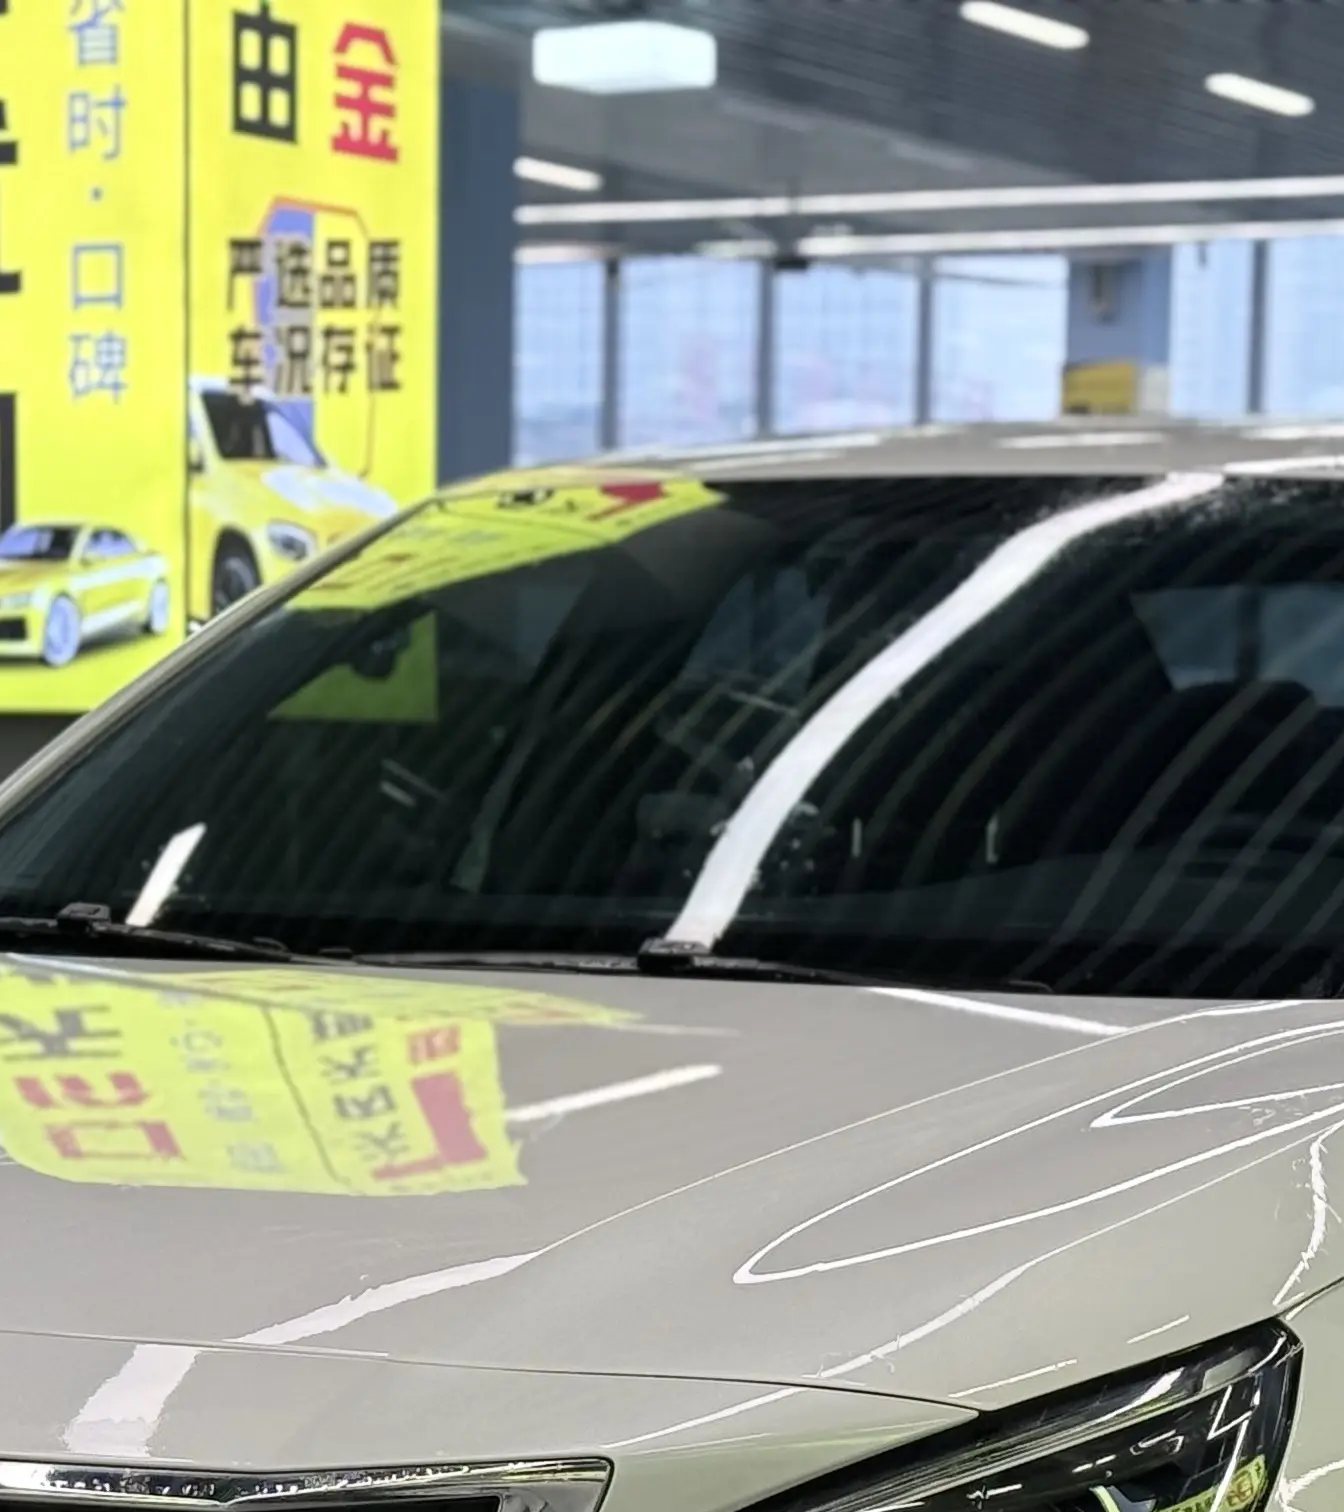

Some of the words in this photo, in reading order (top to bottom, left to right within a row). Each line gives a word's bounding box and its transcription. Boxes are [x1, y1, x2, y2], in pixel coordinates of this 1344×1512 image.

[330, 21, 399, 164] 金
[226, 237, 402, 313] 严选品质
